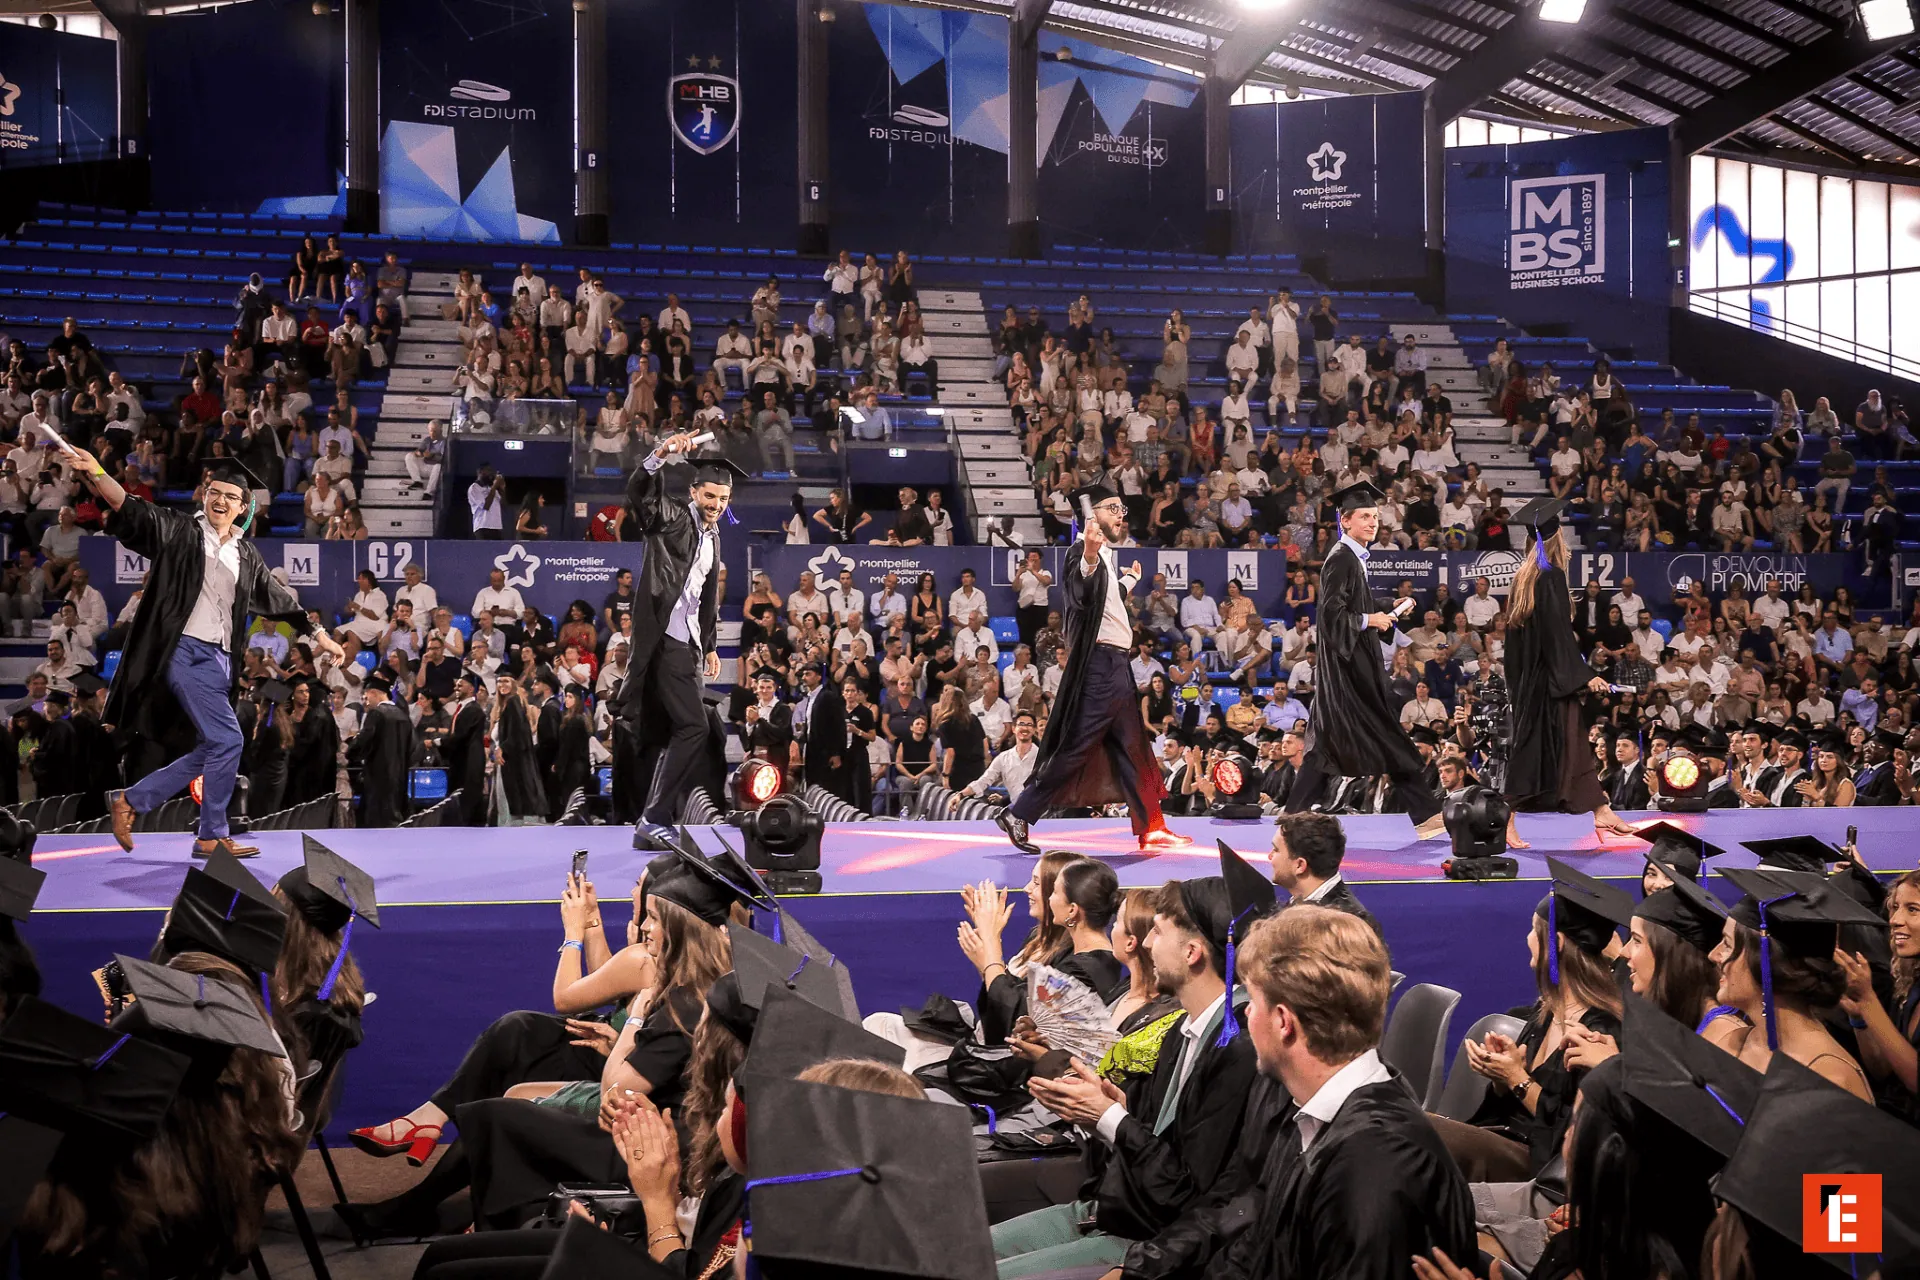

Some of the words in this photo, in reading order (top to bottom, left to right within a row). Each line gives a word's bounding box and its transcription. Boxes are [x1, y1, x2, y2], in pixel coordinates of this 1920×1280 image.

[681, 85, 730, 99] MHB
[128, 140, 136, 153] B
[1093, 133, 1139, 146] BANQUE
[1078, 141, 1139, 155] POPULAIRE
[588, 153, 596, 168] C
[1107, 155, 1121, 163] DU
[1122, 155, 1139, 164] SUD
[811, 186, 819, 200] C
[1216, 188, 1224, 201] D
[1582, 187, 1592, 215] 1897
[1525, 188, 1571, 229] M
[1581, 217, 1592, 251] since
[1511, 229, 1582, 271] BS
[1511, 268, 1581, 281] MONTPELLIER
[1677, 270, 1683, 283] E
[1511, 278, 1560, 290] BUSINESS
[1562, 274, 1604, 285] SCHOOL
[292, 557, 312, 574] M
[1007, 549, 1025, 583] G
[1164, 563, 1182, 579] M
[1366, 560, 1393, 569] onade
[1394, 560, 1433, 570] originale
[1460, 561, 1524, 578] Limone
